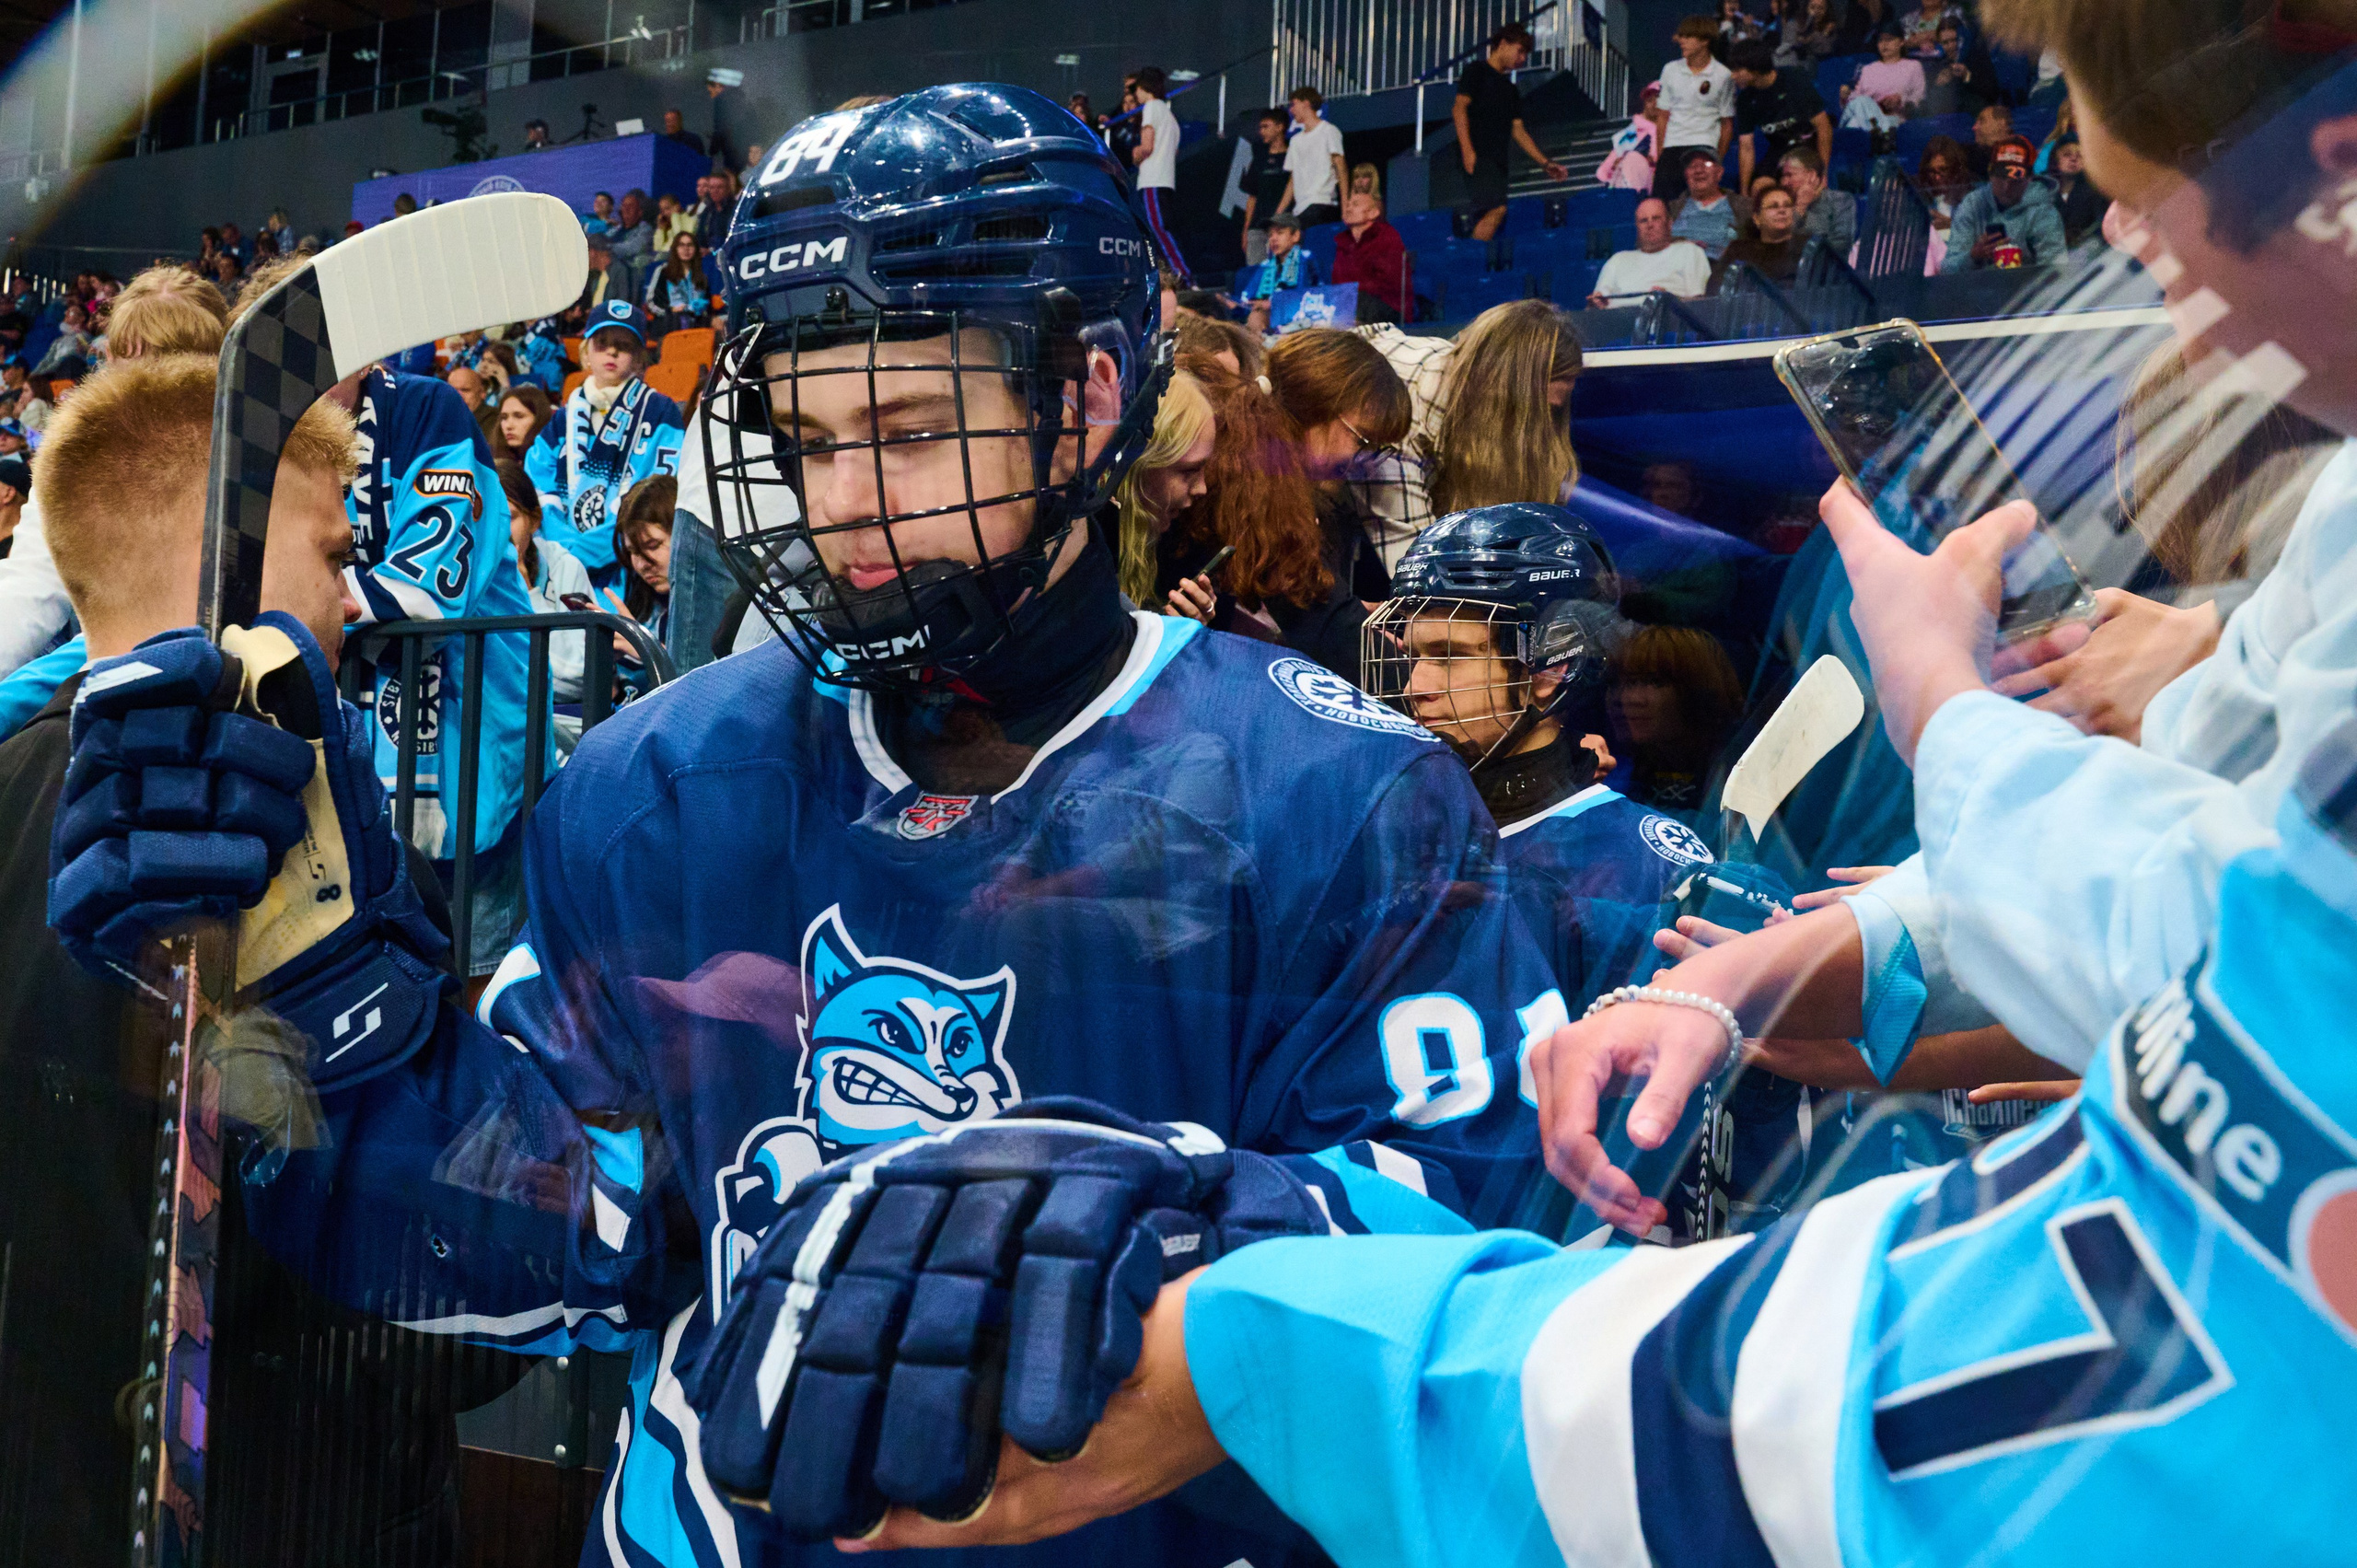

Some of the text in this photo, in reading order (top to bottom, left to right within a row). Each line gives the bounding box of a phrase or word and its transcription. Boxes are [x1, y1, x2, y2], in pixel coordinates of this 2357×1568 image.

[758, 114, 862, 187] 84
[739, 236, 848, 280] CCM
[1098, 237, 1141, 258] CCM
[633, 422, 652, 455] C
[385, 504, 475, 600] 23
[1528, 569, 1581, 583] BAUER
[834, 624, 931, 661] CCM
[1546, 645, 1585, 667] BAUER
